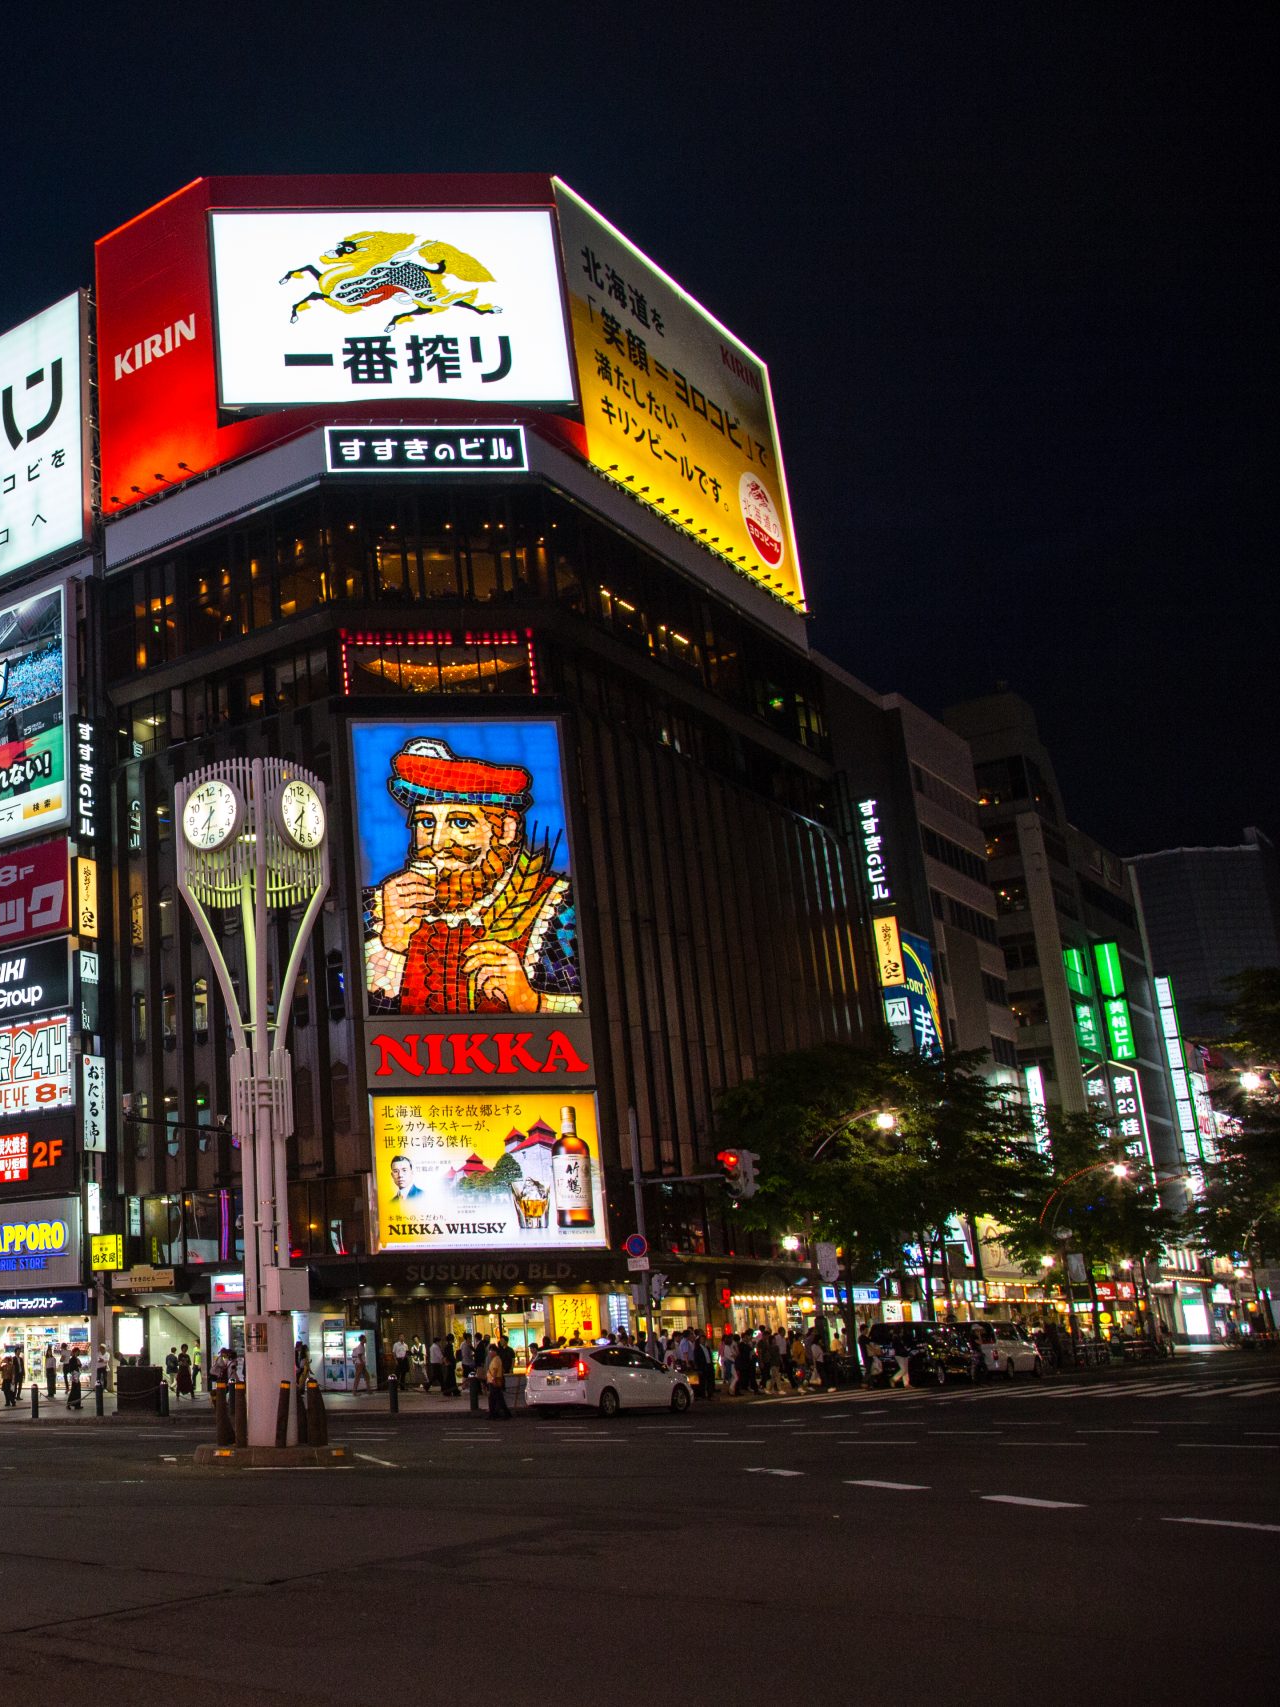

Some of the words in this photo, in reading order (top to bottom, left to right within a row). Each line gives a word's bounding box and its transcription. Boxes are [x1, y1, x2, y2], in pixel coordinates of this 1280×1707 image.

[581, 246, 665, 338] 北海道を
[114, 313, 196, 381] KIRIN
[283, 334, 513, 385] 一番搾り
[721, 344, 760, 394] KIRIN
[595, 348, 687, 442] 満たしたい、
[339, 437, 514, 463] すすきのビル
[601, 395, 729, 512] キリンビールです。
[78, 723, 95, 837] すすきのビル
[206, 787, 215, 797] 12
[218, 788, 222, 796] 1
[290, 787, 296, 796] 11
[297, 786, 304, 796] 12
[198, 794, 204, 803] 11
[225, 794, 230, 803] 2
[285, 794, 292, 804] 10
[307, 793, 310, 802] 1
[32, 799, 51, 813] 検索
[192, 804, 200, 813] 10
[229, 805, 233, 814] 3
[284, 806, 288, 814] 9
[312, 803, 316, 811] 2
[190, 816, 194, 825] 9
[226, 818, 230, 827] 4
[287, 818, 291, 827] 8
[315, 815, 319, 824] 3
[193, 828, 198, 836] 8
[219, 829, 224, 838] 5
[293, 828, 298, 837] 7
[313, 827, 316, 835] 4
[201, 834, 206, 843] 7
[209, 834, 215, 843] 6
[301, 833, 305, 843] 6
[308, 833, 312, 842] 5
[859, 800, 889, 900] すすきのビル
[1109, 1001, 1132, 1058] 美松ビル
[13, 1025, 68, 1080] 24H
[371, 1030, 589, 1076] NIKKA
[35, 1082, 68, 1102] 8F
[381, 1105, 423, 1118] 北海道
[428, 1104, 523, 1118] 余市を故郷とする
[383, 1135, 478, 1149] 世界に誇る傑作。
[32, 1139, 63, 1168] 2F
[565, 1162, 582, 1195] 竹鶴
[388, 1223, 442, 1236] NIKKA
[446, 1222, 507, 1234] WHISKY
[20, 1256, 47, 1270] STORE
[407, 1263, 518, 1282] SUSUKINO
[528, 1262, 577, 1280] BLD.
